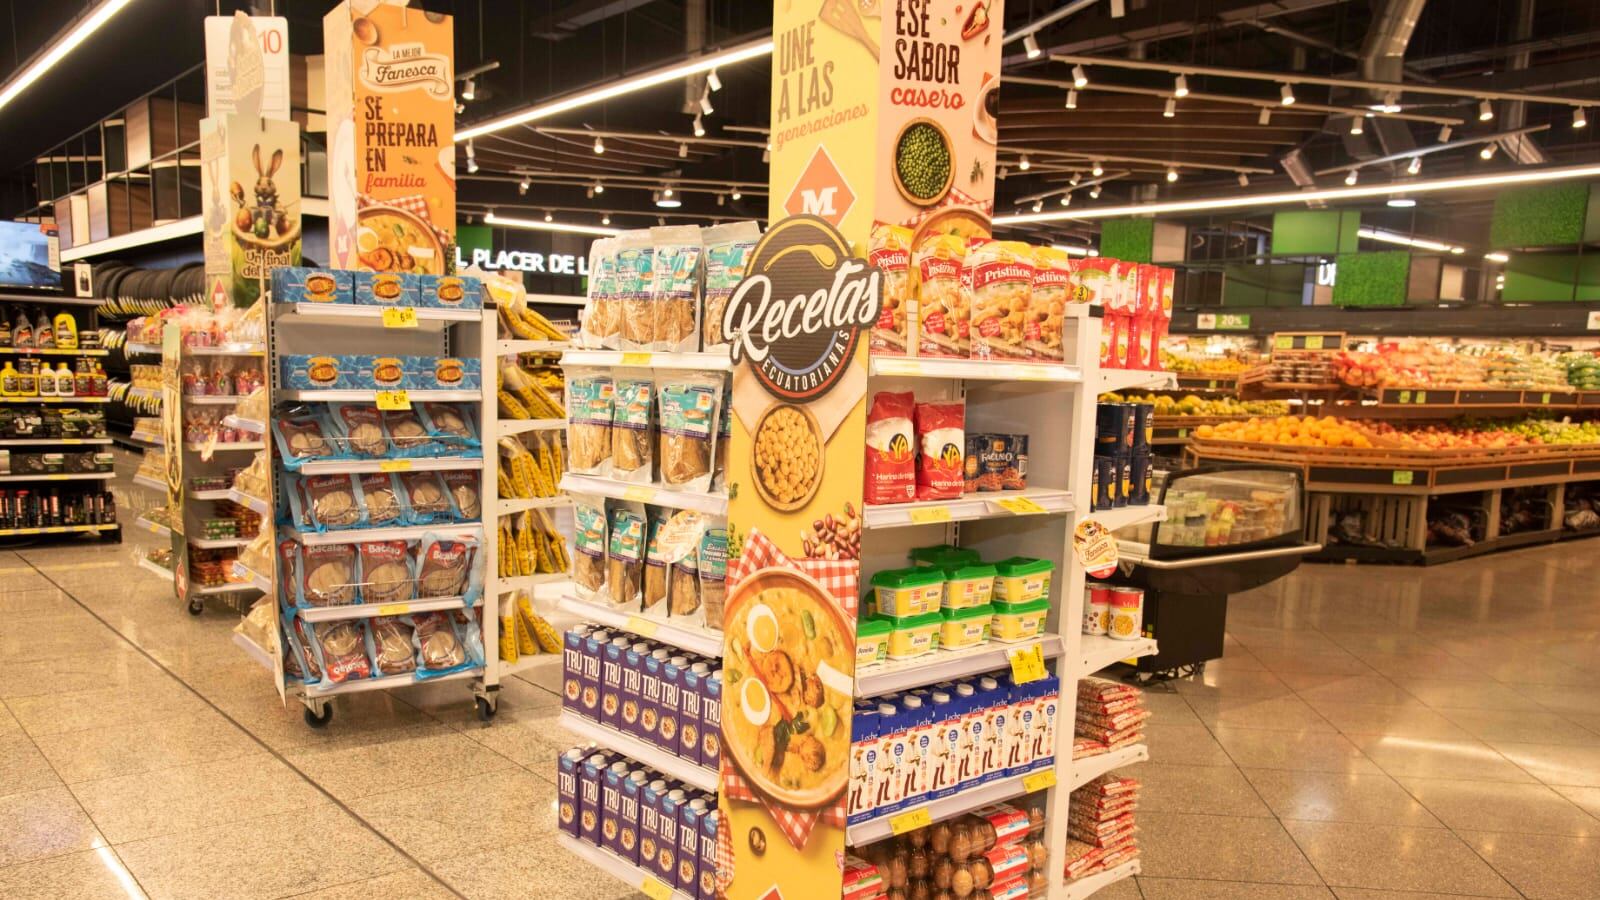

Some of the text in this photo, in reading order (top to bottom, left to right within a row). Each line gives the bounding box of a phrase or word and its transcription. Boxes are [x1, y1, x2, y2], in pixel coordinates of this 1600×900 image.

[895, 0, 930, 38] ESE
[259, 29, 282, 54] 10
[401, 47, 422, 59] MEJOR
[779, 19, 816, 76] UNE
[375, 64, 437, 83] Fanesca
[894, 38, 960, 84] SABOR
[777, 60, 835, 123] A LAS
[890, 87, 965, 110] casero
[365, 95, 383, 121] SE
[365, 123, 438, 147] PREPARA
[776, 103, 870, 151] generaciones
[365, 148, 386, 173] EN
[365, 173, 427, 194] familia
[801, 186, 838, 216] M
[455, 246, 589, 275] L PLACER DE L
[985, 265, 1031, 282] Pristiños
[1032, 271, 1067, 285] ristiños
[723, 260, 879, 362] Recetas
[762, 330, 850, 391] ECUATORIANAS
